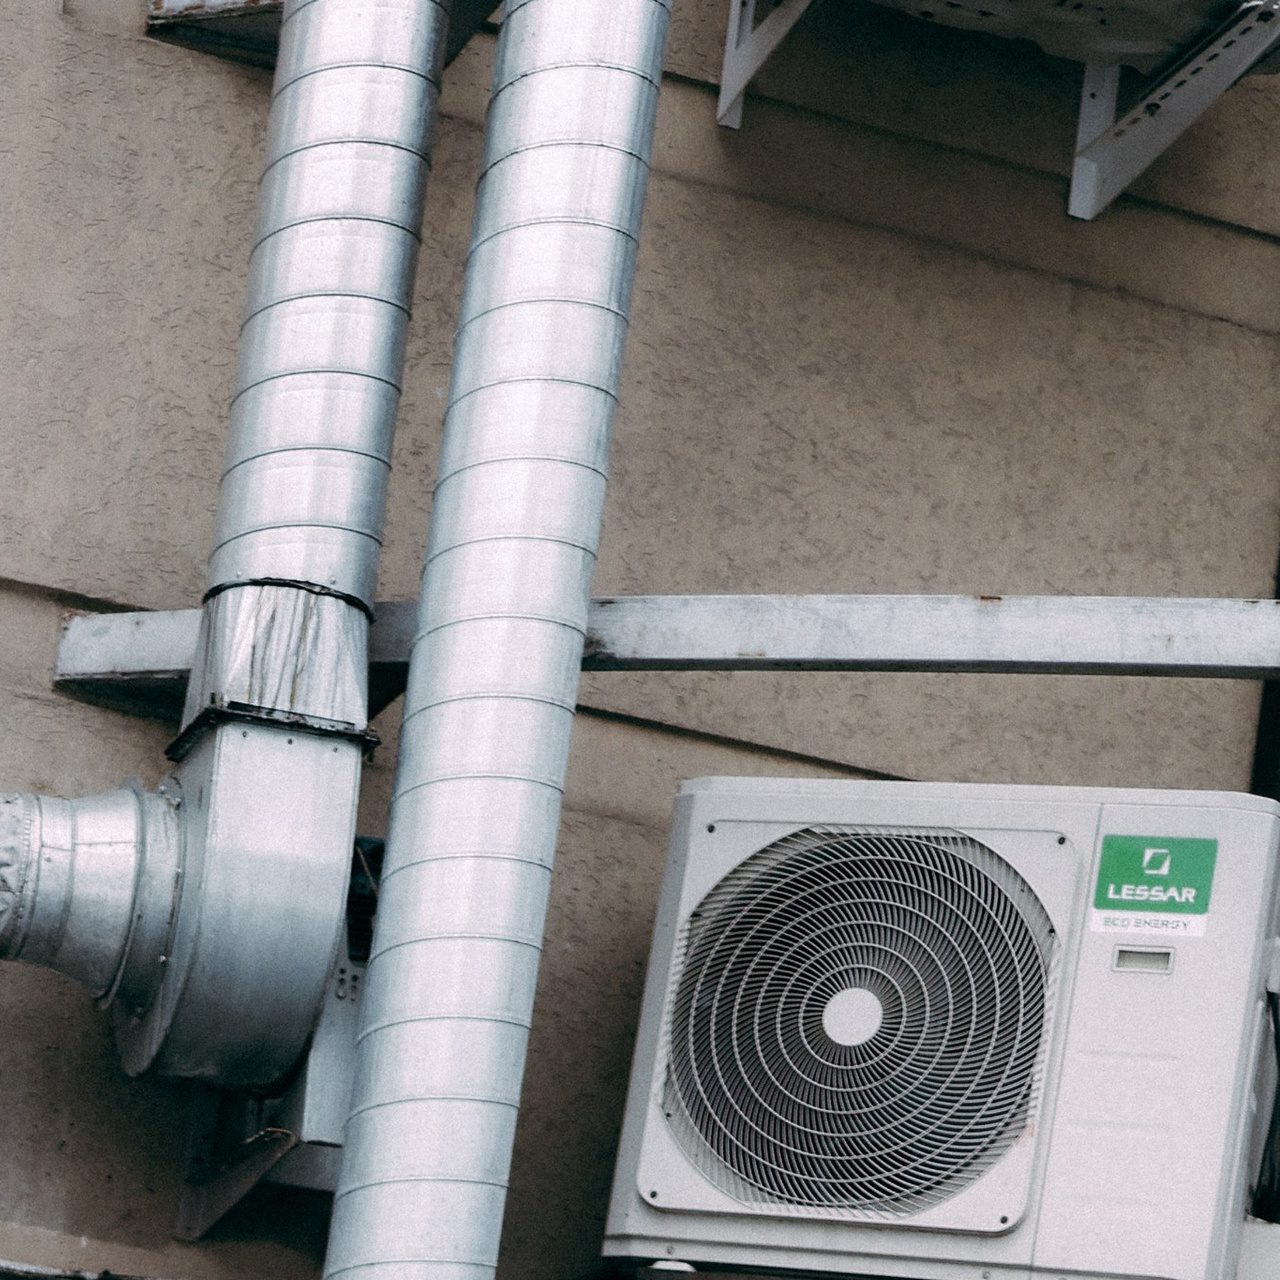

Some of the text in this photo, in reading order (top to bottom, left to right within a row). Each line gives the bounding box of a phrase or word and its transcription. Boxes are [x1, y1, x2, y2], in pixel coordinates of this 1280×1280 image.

[1108, 884, 1196, 902] LESSAR
[1104, 917, 1190, 929] ECO ENERGY
